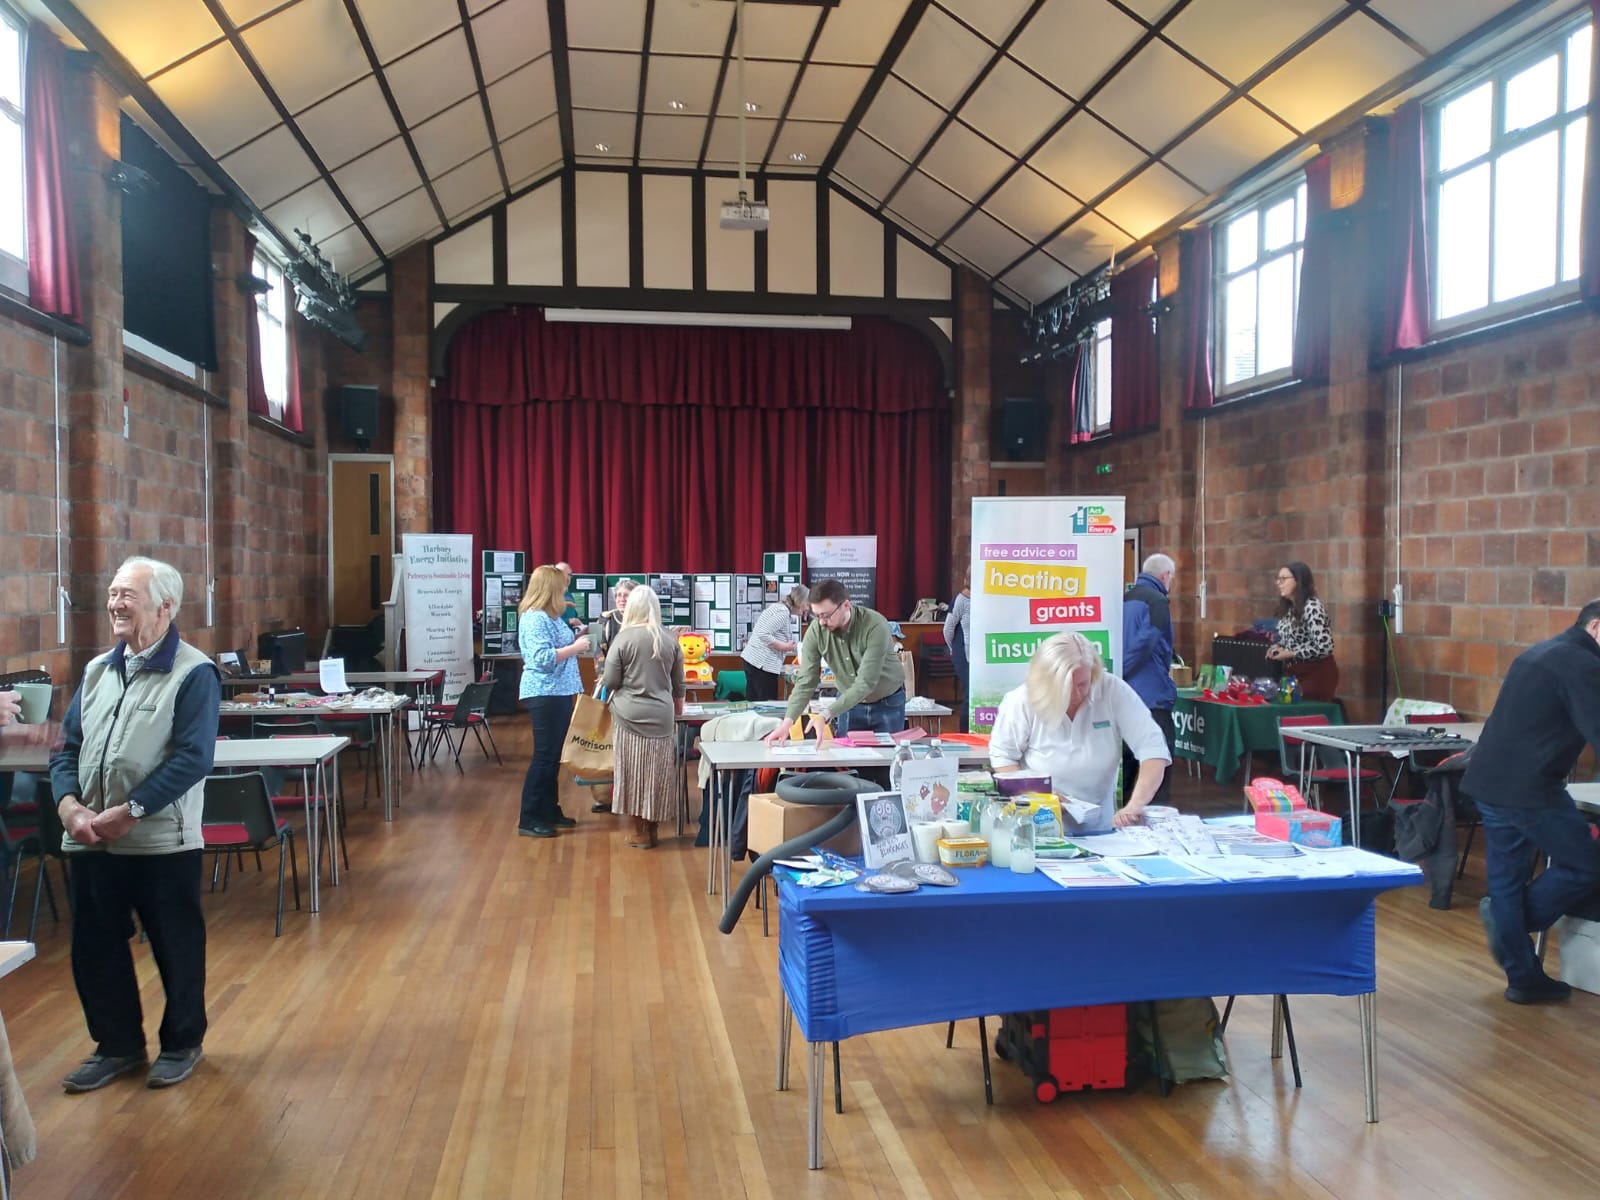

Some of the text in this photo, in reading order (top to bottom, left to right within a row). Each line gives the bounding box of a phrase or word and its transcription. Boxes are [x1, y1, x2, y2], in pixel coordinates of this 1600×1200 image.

[1089, 507, 1102, 515] Act
[1088, 516, 1100, 525] On
[1088, 525, 1113, 535] Energy
[984, 546, 1076, 558] free advice on
[409, 553, 469, 565] Energy Initiative
[991, 568, 1080, 596] heating
[1036, 601, 1096, 623] grants
[1171, 706, 1205, 735] cycle
[955, 850, 980, 858] FLORA
